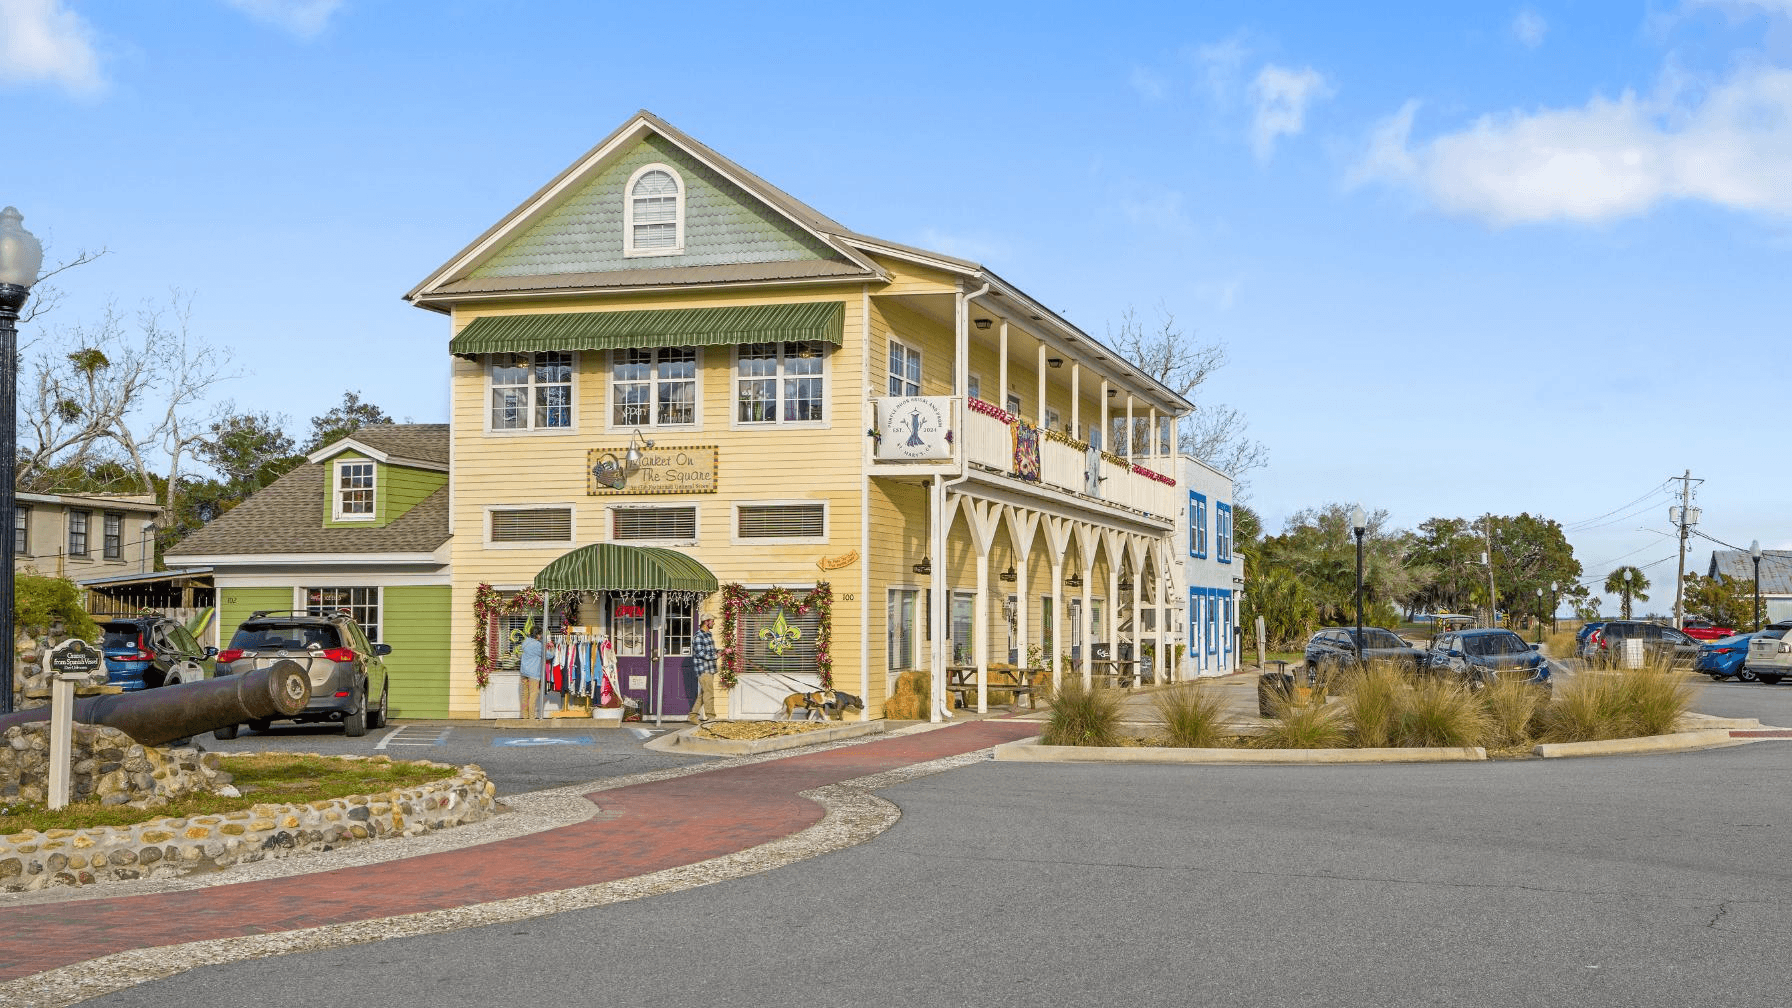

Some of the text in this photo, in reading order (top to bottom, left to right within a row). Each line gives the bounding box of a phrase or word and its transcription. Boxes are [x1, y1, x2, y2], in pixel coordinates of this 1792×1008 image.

[676, 453, 694, 466] On
[641, 468, 712, 483] The Square
[615, 605, 645, 617] OPEN
